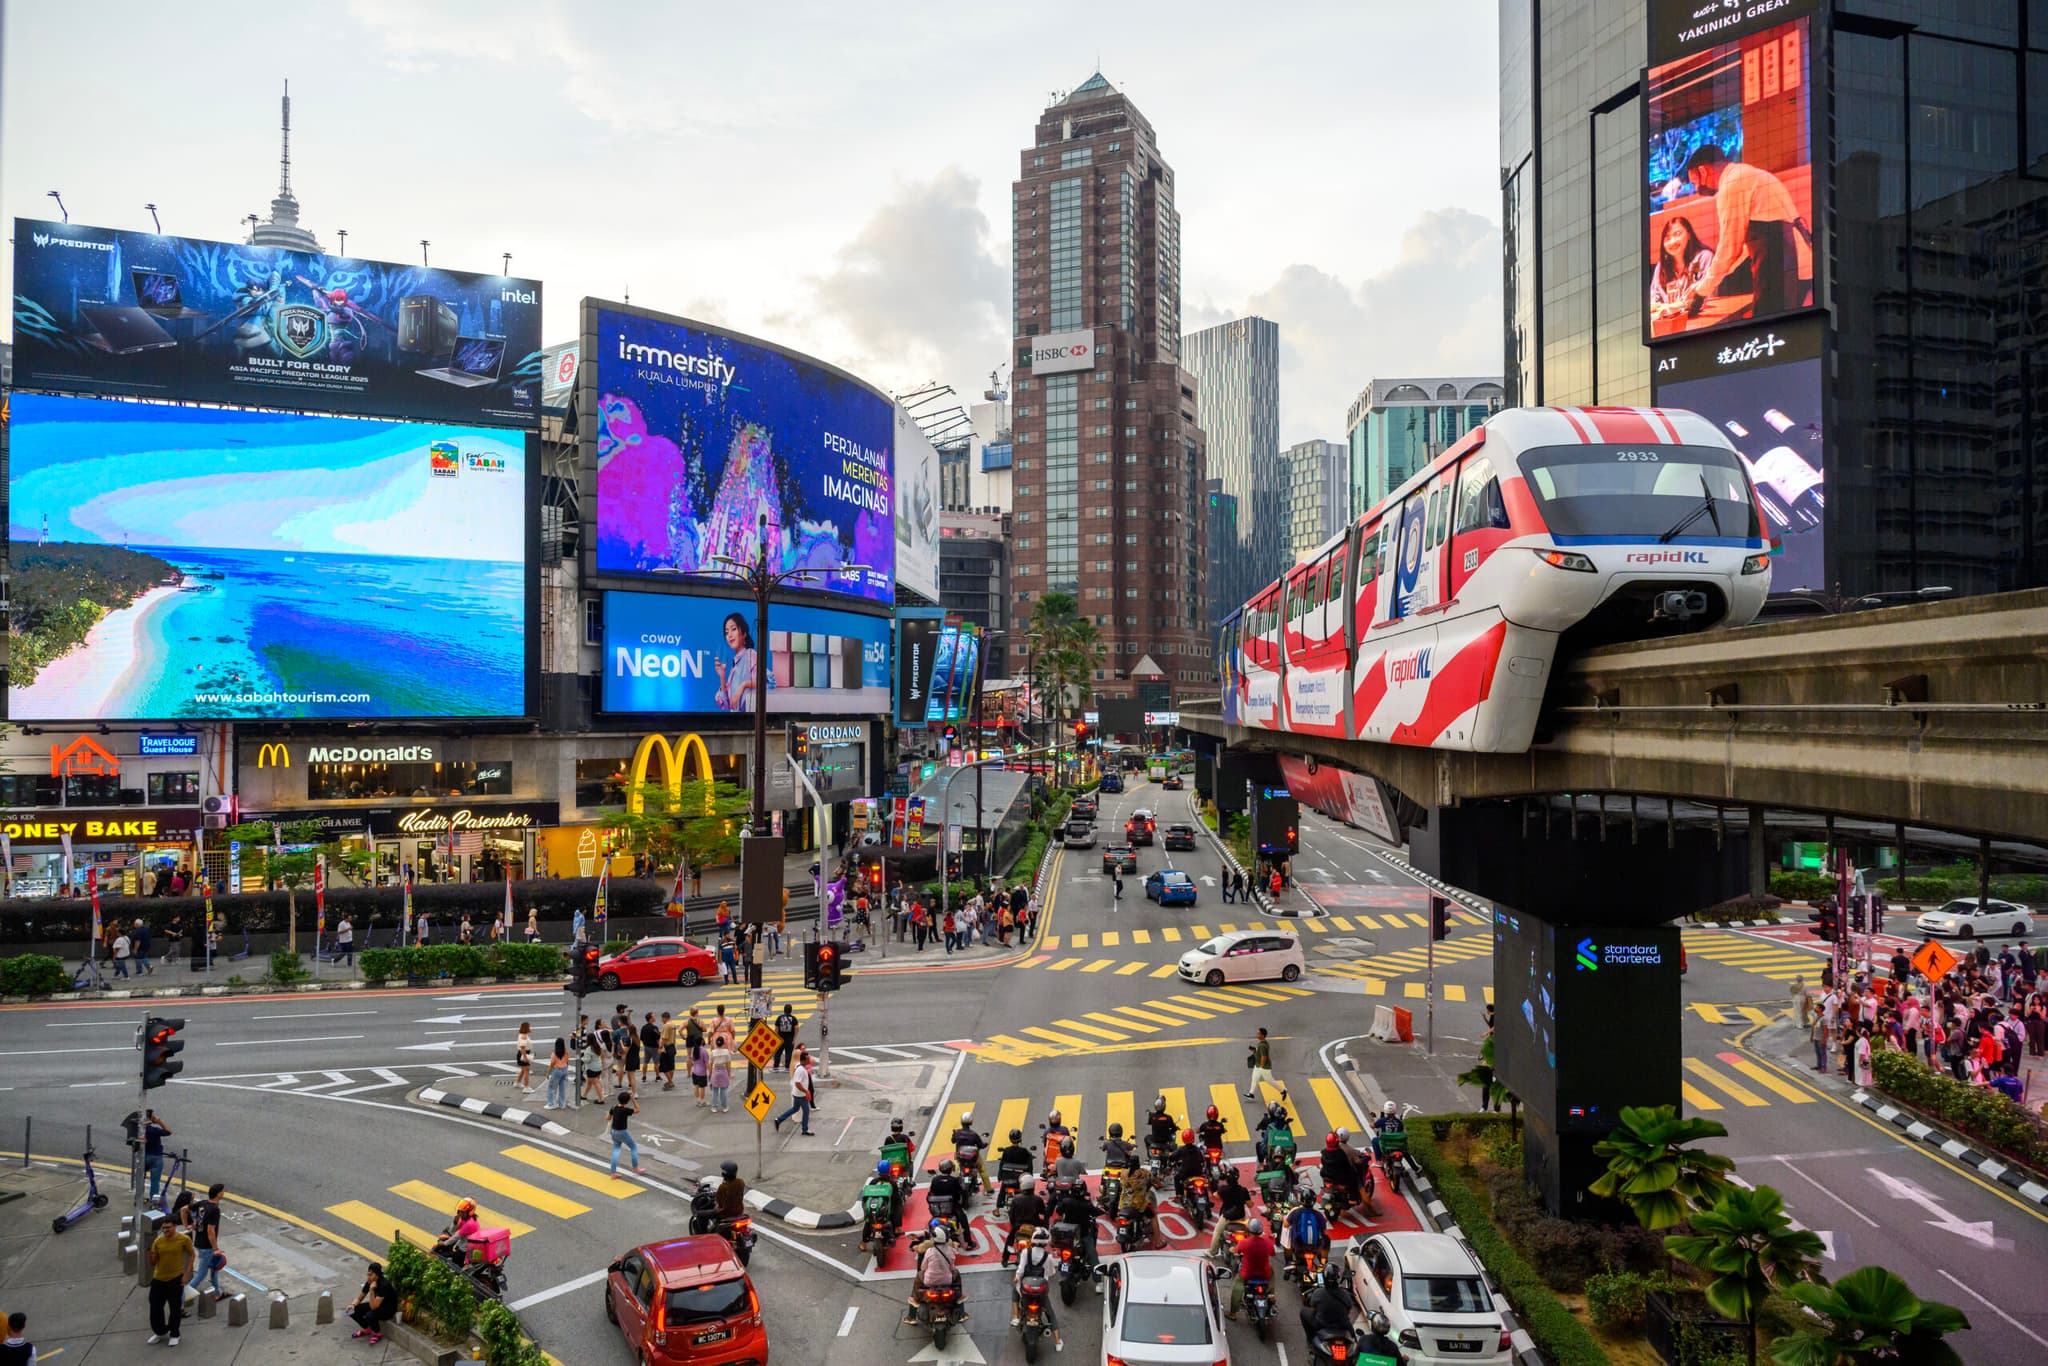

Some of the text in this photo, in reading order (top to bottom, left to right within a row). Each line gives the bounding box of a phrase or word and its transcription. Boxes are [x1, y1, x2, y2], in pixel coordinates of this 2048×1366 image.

[1678, 12, 1742, 43] YAKINIKU
[1746, 0, 1791, 18] GREAT
[51, 237, 115, 252] PREDATOR
[619, 334, 736, 386] immersify
[1035, 347, 1068, 361] HSBC
[229, 365, 249, 373] ASIA
[249, 367, 281, 375] PACIFIC
[281, 370, 320, 379] PREDATOR
[321, 373, 349, 381] LEAGUE
[249, 357, 351, 373] BUILT FOR GLORY
[637, 368, 718, 394] KUALA LUMPUR
[823, 431, 886, 471] PERJALANAN
[1617, 451, 1659, 462] 2933
[469, 458, 505, 468] SABAH
[842, 458, 888, 492] MERENTAS
[823, 474, 888, 517] IMAGINASI
[1464, 550, 1478, 571] 2933
[1626, 551, 1710, 565] rapidKL
[840, 569, 860, 582] LABS
[640, 633, 682, 646] coway
[912, 643, 921, 688] PREDATOR
[1390, 647, 1432, 689] rapidKL
[194, 691, 371, 703] www.sabahtourism.com
[810, 725, 861, 741] GIORDANO
[308, 745, 433, 763] McDonald's
[398, 808, 532, 833] Kadir Pasembor
[86, 821, 158, 837] BAKE
[1604, 944, 1658, 955] standard
[1604, 953, 1661, 964] chartered
